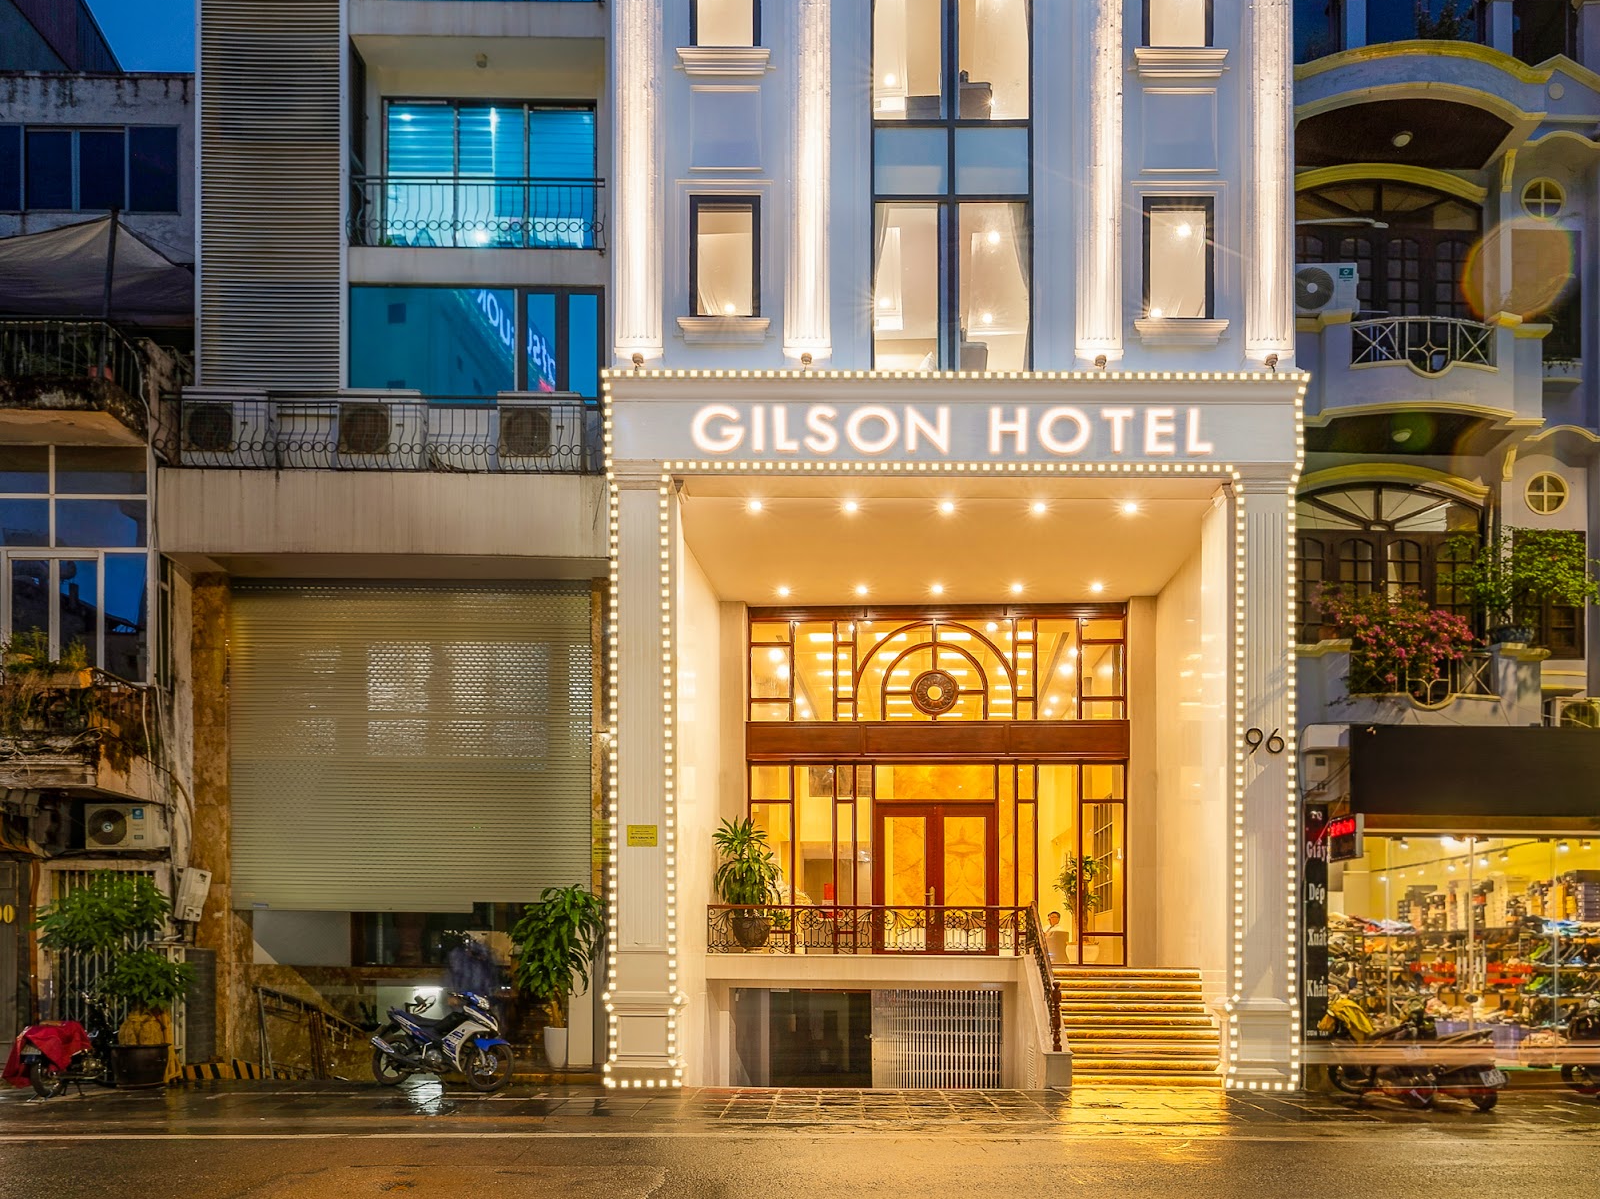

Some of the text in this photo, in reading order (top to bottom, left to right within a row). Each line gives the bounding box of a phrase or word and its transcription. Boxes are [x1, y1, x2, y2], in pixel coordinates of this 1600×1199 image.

[691, 404, 1215, 456] GILSON HOTEL
[1246, 727, 1284, 754] 96
[1308, 883, 1326, 905] Dép
